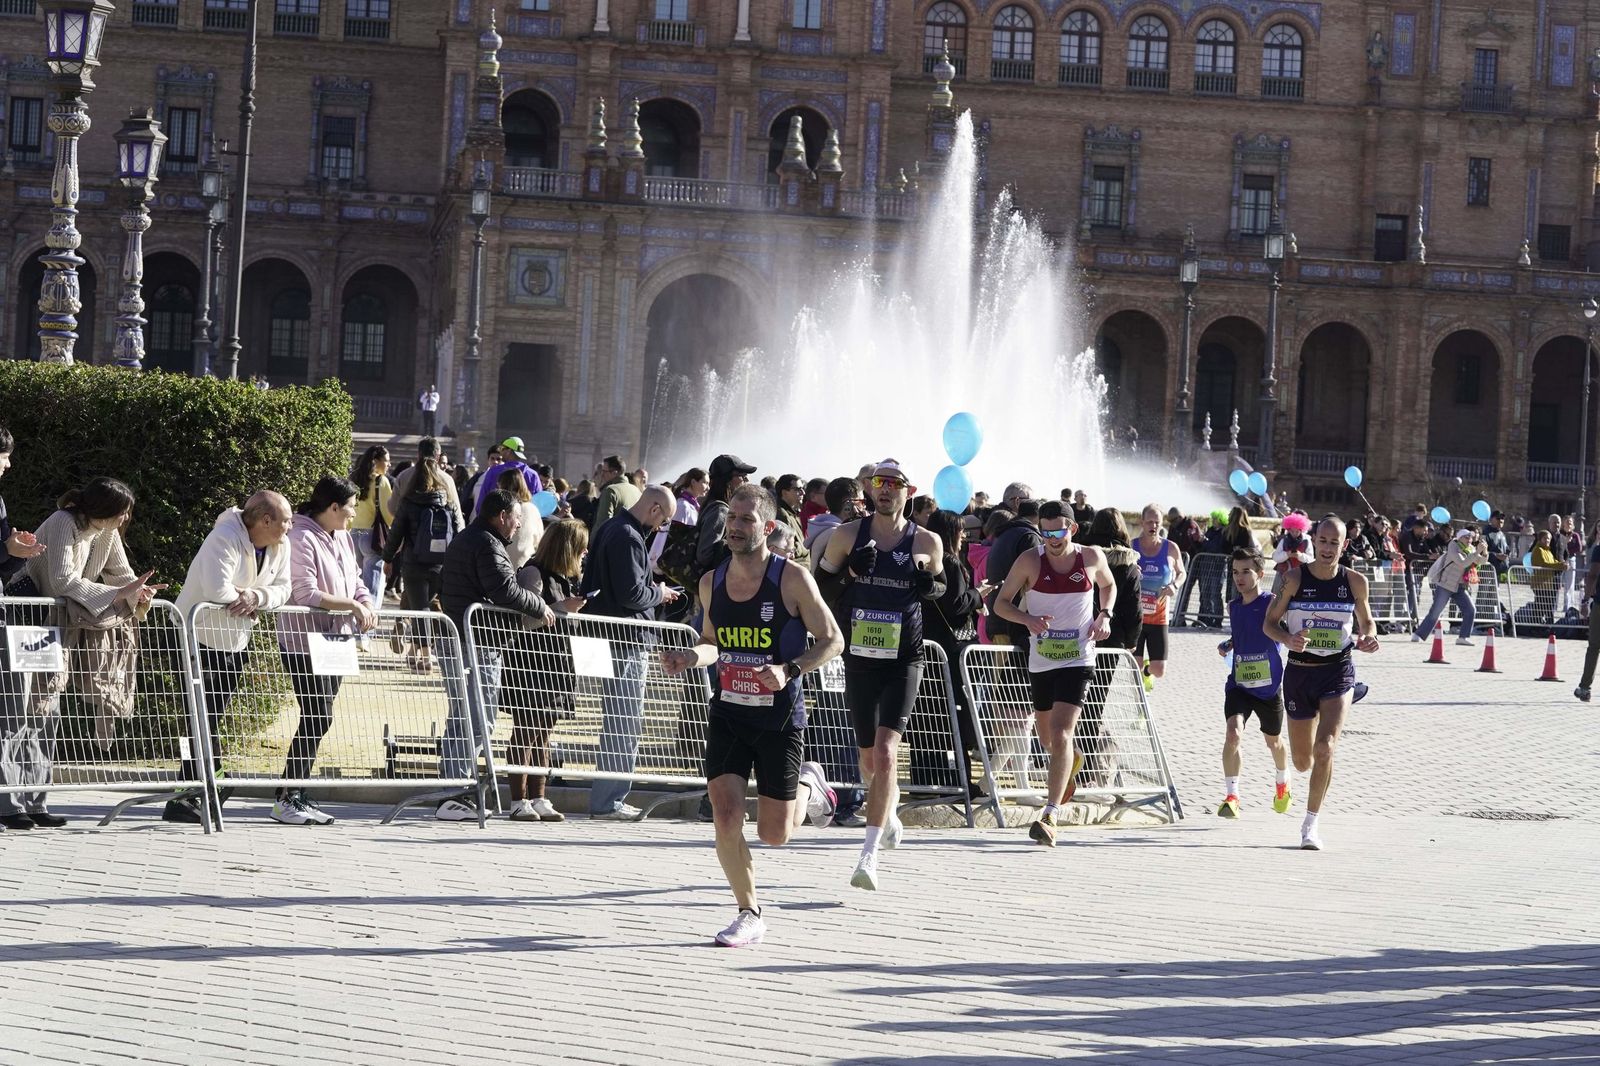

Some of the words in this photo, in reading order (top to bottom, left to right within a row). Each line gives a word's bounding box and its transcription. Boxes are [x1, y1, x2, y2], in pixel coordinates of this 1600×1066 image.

[866, 612, 896, 621] ZURICH
[867, 626, 882, 634] 1610
[717, 627, 772, 648] CHRIS
[862, 636, 885, 647] RICH
[734, 655, 765, 665] ZURICH
[1038, 650, 1081, 660] LEKSANDER
[1243, 654, 1265, 662] ZURICH
[736, 671, 753, 679] 1133
[1242, 671, 1262, 681] HUGO
[732, 679, 761, 694] CHRIS
